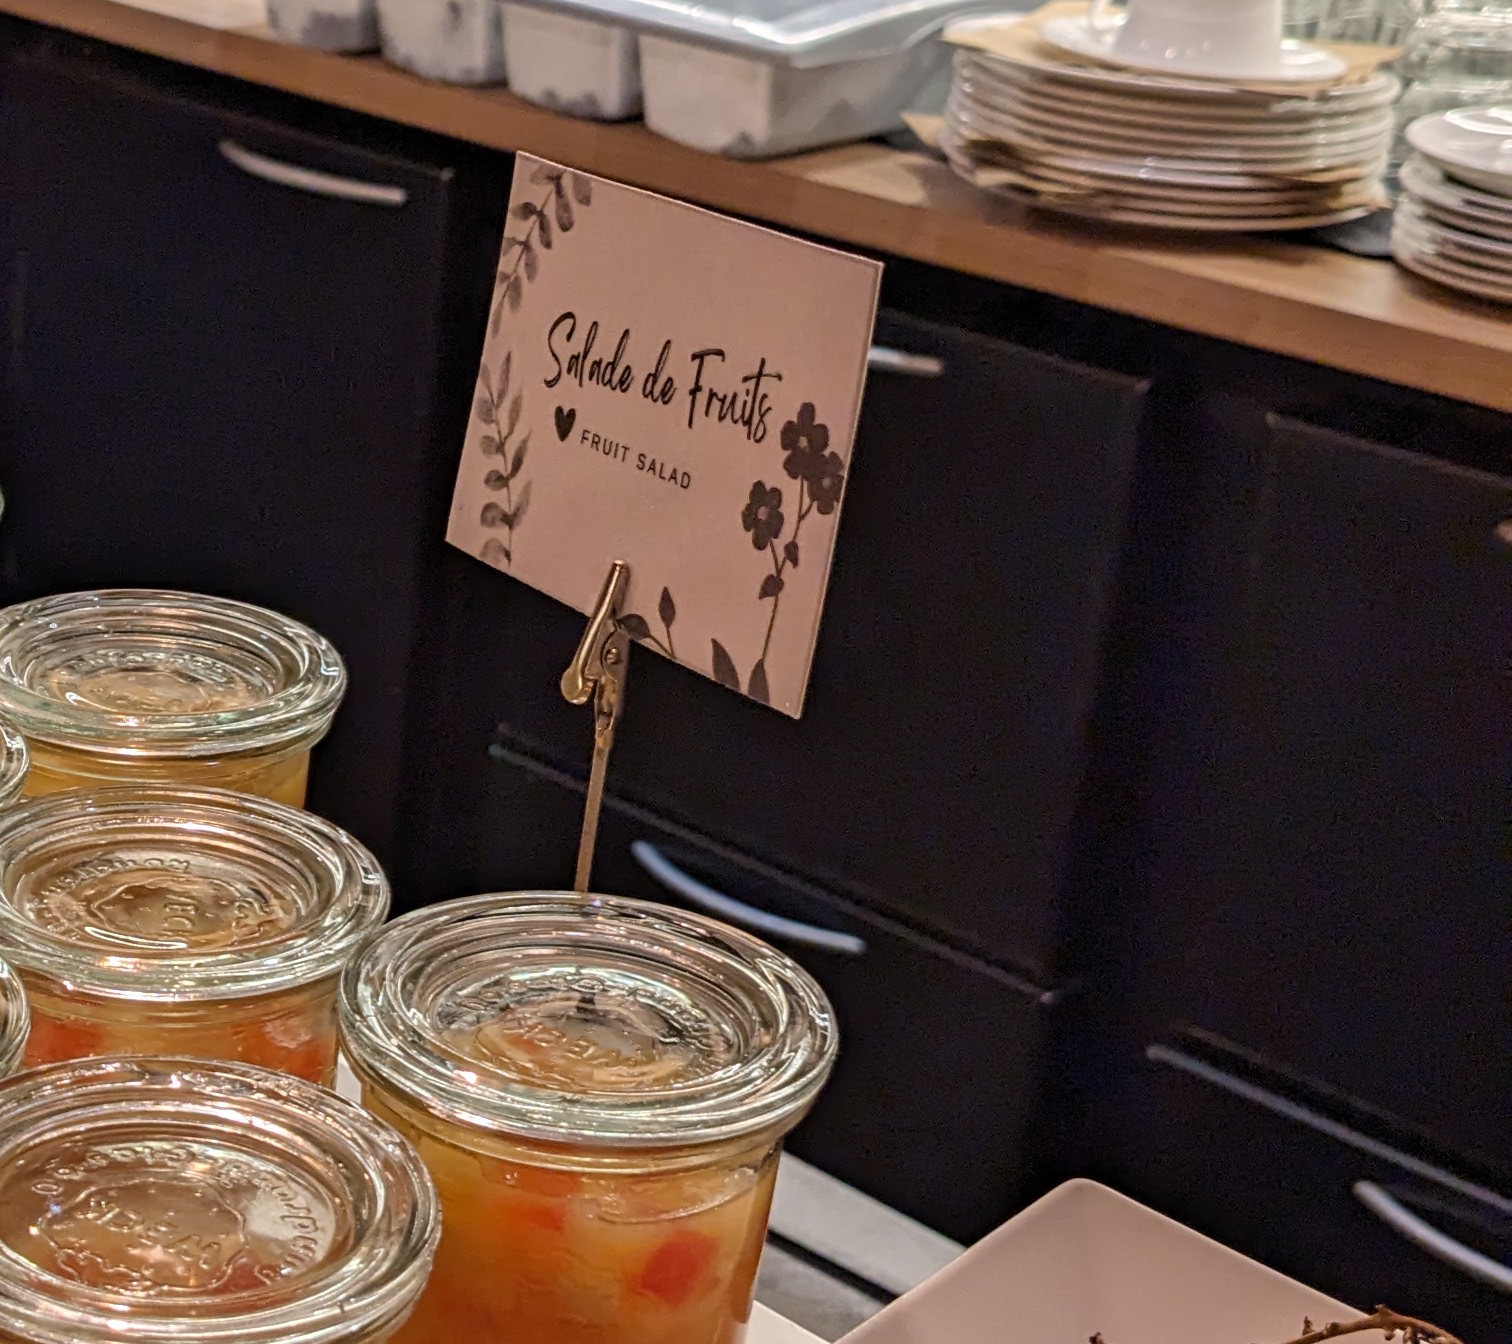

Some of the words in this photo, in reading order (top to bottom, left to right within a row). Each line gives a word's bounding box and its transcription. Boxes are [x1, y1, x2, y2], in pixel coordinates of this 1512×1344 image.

[544, 311, 634, 394] Salade
[642, 339, 677, 405] de
[689, 348, 784, 444] Fruits
[580, 429, 630, 463] FRUIT
[636, 453, 691, 490] SALAD
